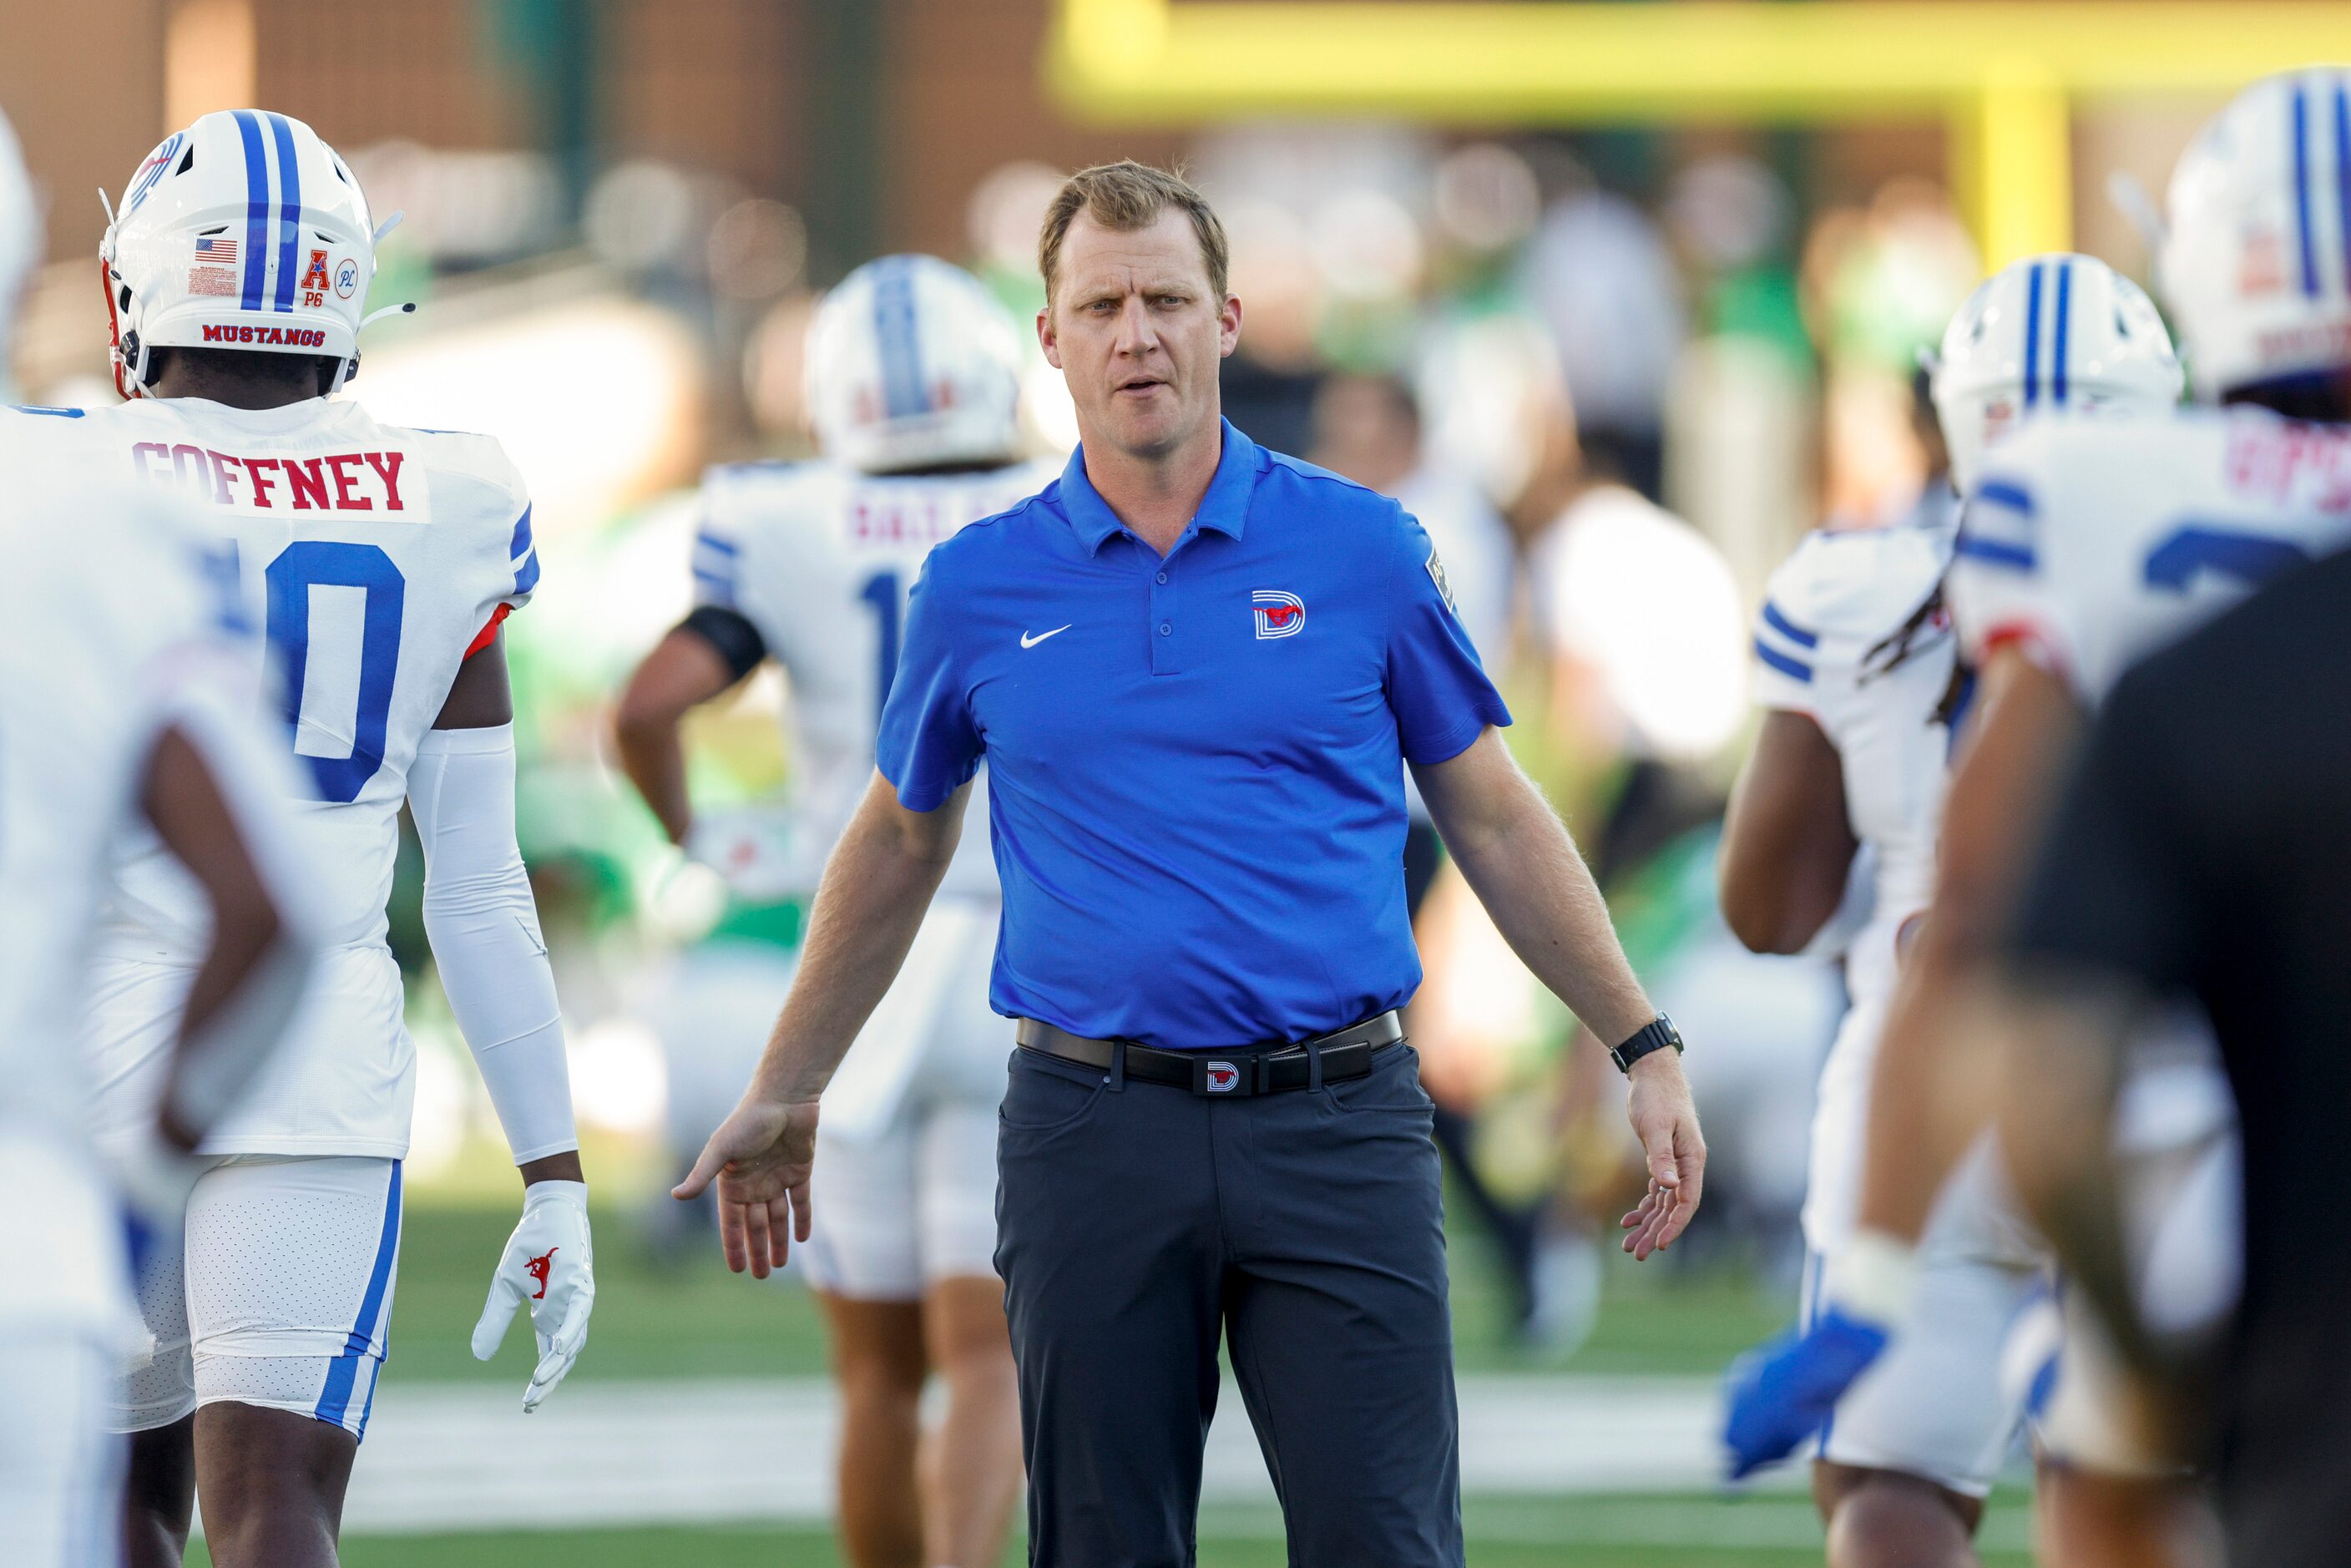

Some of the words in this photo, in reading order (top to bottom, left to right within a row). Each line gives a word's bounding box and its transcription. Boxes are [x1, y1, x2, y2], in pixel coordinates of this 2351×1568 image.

[338, 270, 356, 287] PL
[304, 291, 324, 307] P6
[202, 324, 326, 347] MUSTANGS
[132, 441, 405, 511] GOFFNEY
